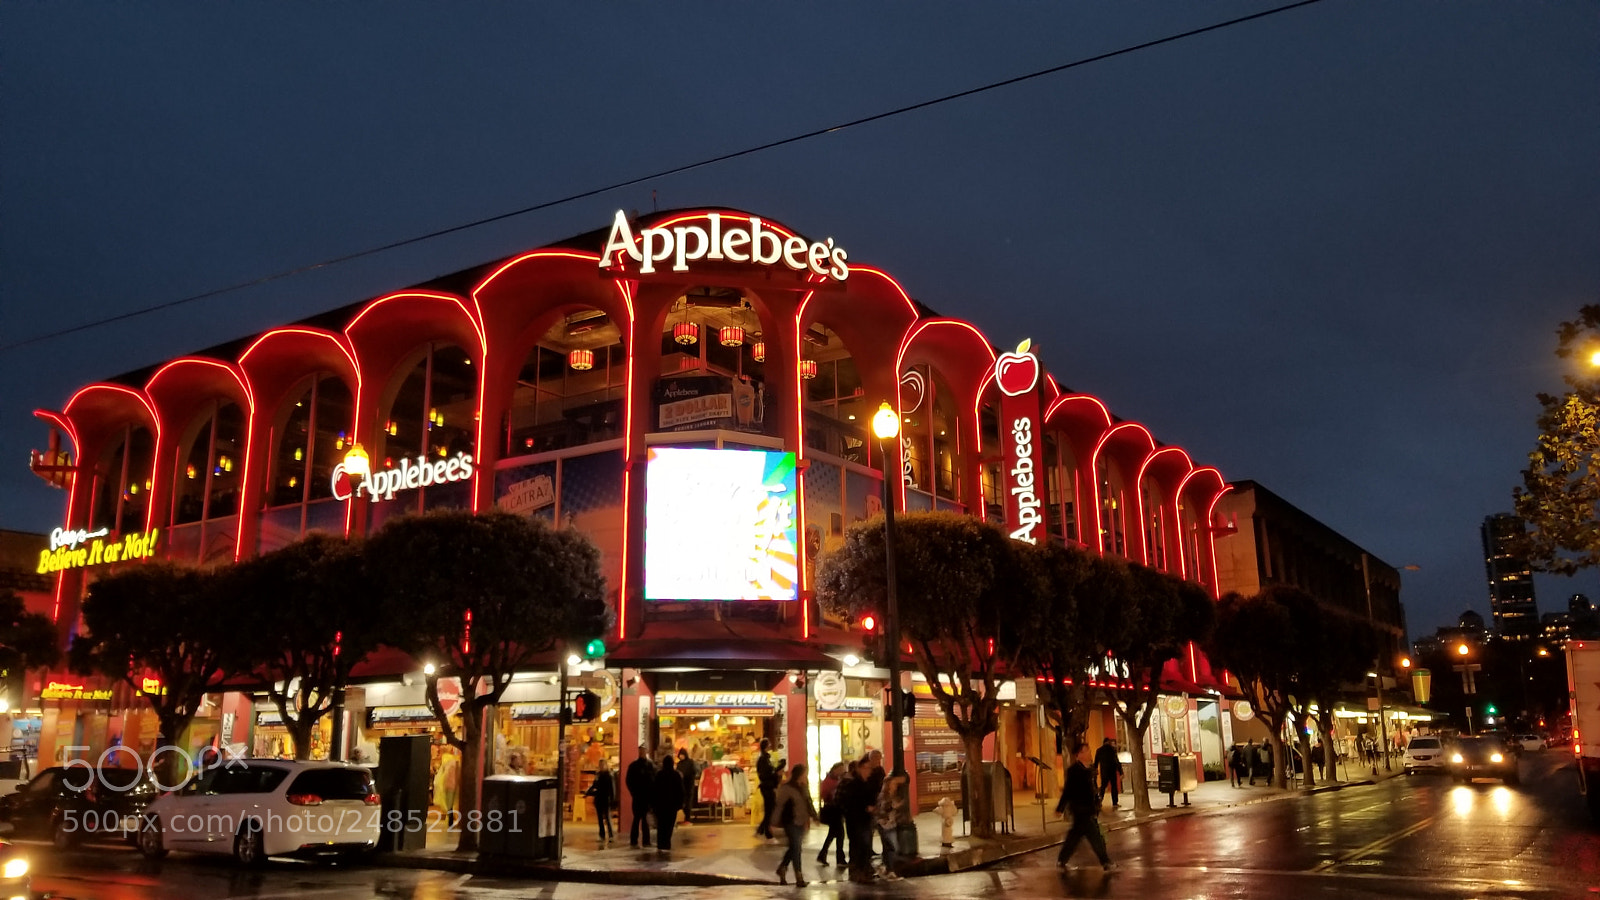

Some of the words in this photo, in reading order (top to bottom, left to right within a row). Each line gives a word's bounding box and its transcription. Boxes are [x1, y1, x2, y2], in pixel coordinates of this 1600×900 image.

[598, 208, 849, 281] Applebee's
[356, 451, 473, 502] Applebee's
[1009, 417, 1042, 546] Applebee's
[36, 546, 87, 574] Believe
[87, 539, 104, 566] It
[103, 542, 122, 563] or
[121, 527, 158, 561] Not!
[664, 694, 711, 705] WHARF
[714, 694, 768, 706] CENTRAL
